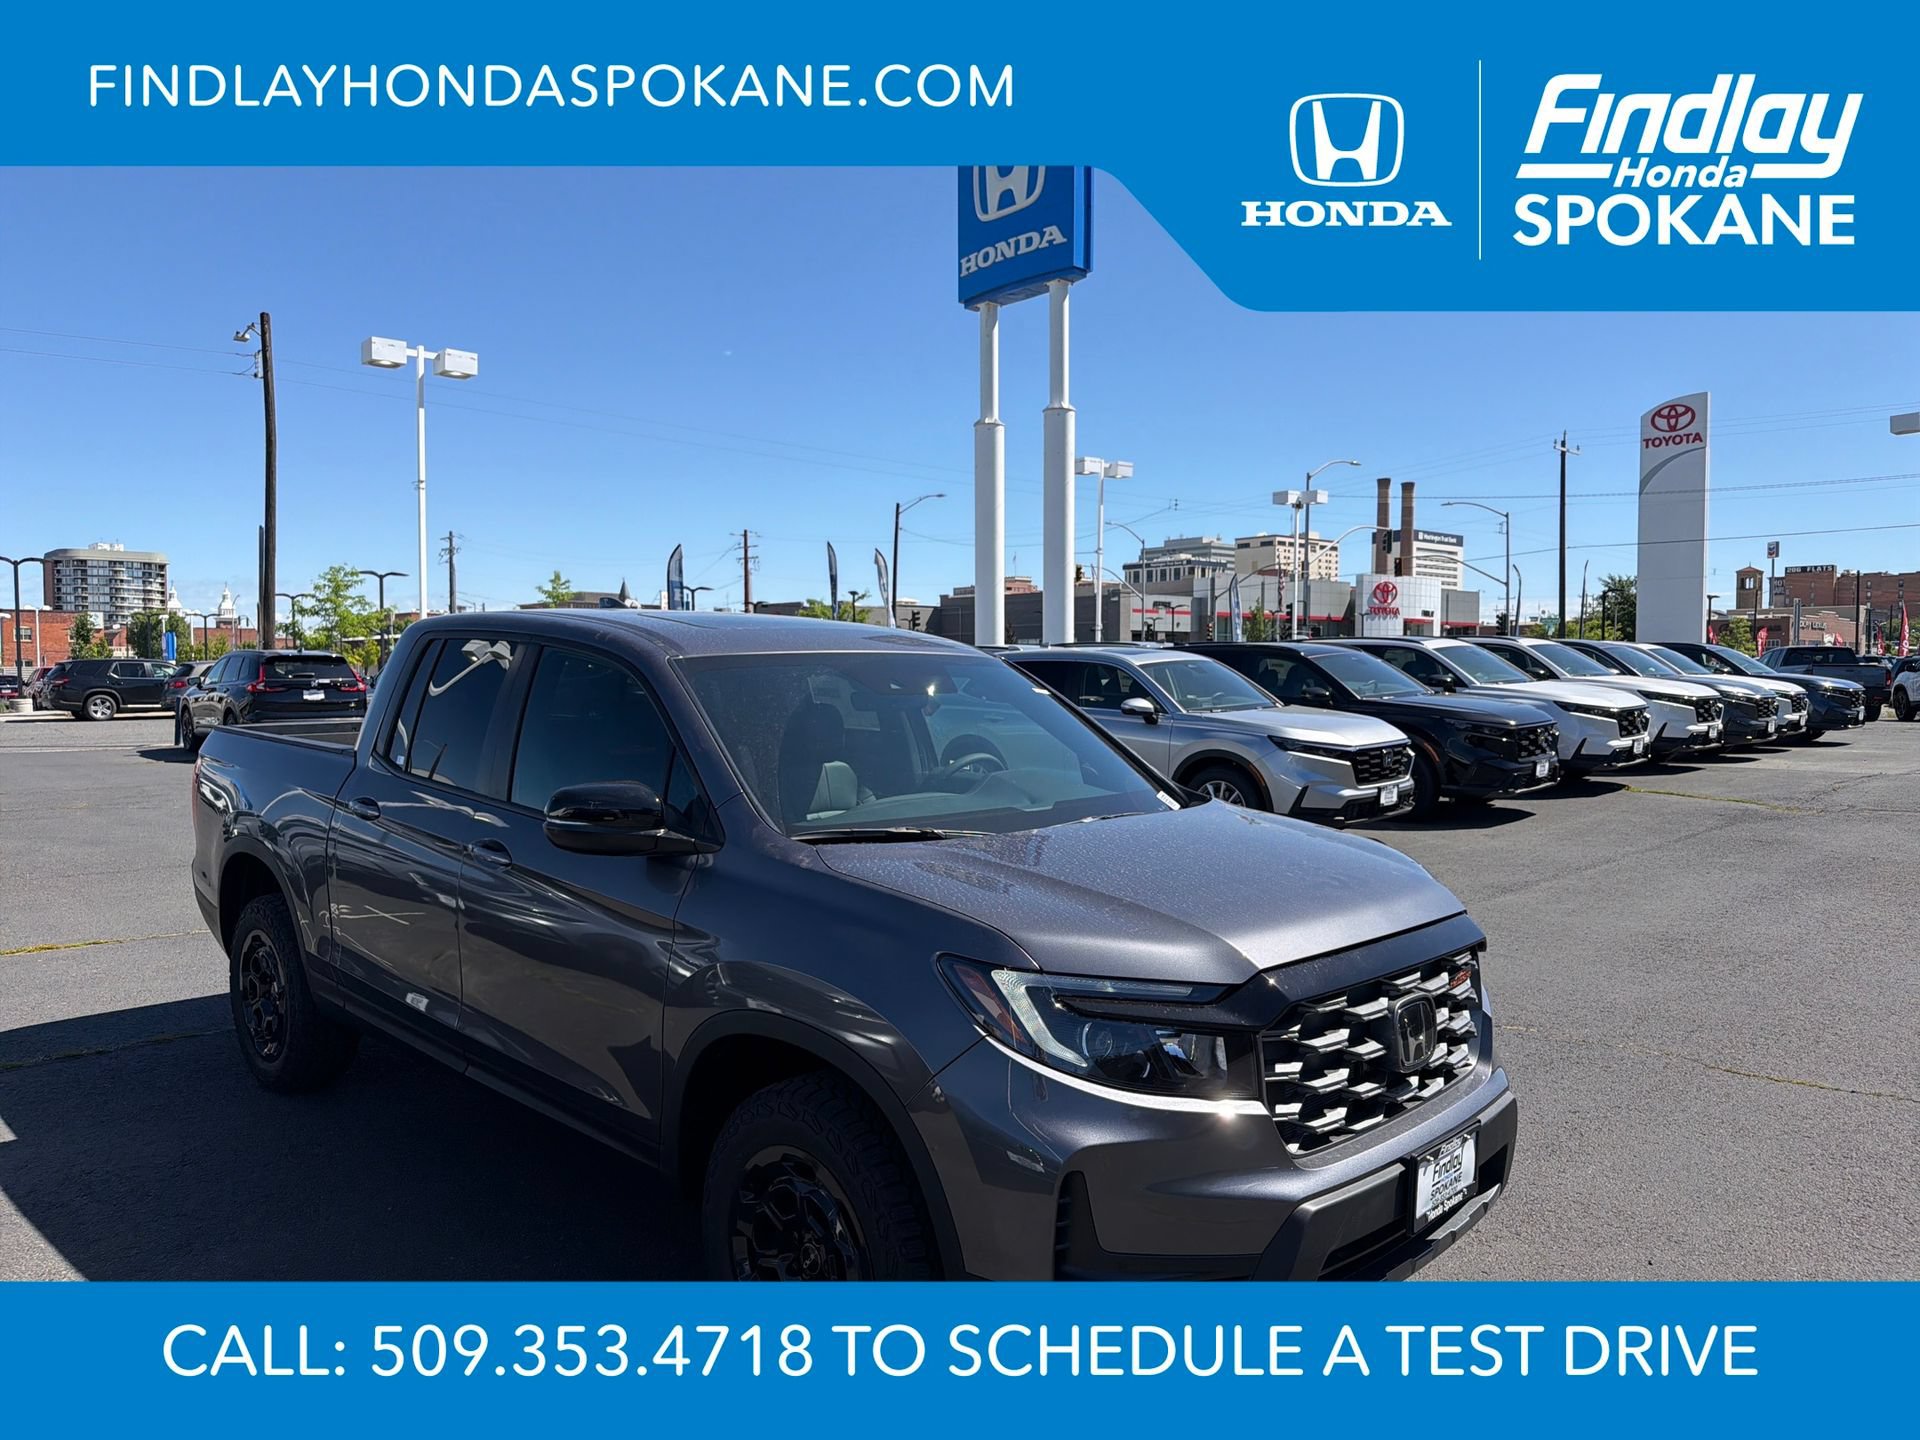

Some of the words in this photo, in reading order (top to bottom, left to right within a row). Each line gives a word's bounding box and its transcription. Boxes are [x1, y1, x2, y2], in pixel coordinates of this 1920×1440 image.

[960, 225, 1068, 277] HONDA
[1643, 432, 1704, 449] TOYOTA
[1368, 606, 1400, 616] TOYOTA
[1432, 1148, 1463, 1184] Findlay
[1430, 1172, 1463, 1200] SPOKANE
[1443, 1192, 1464, 1211] Spokane
